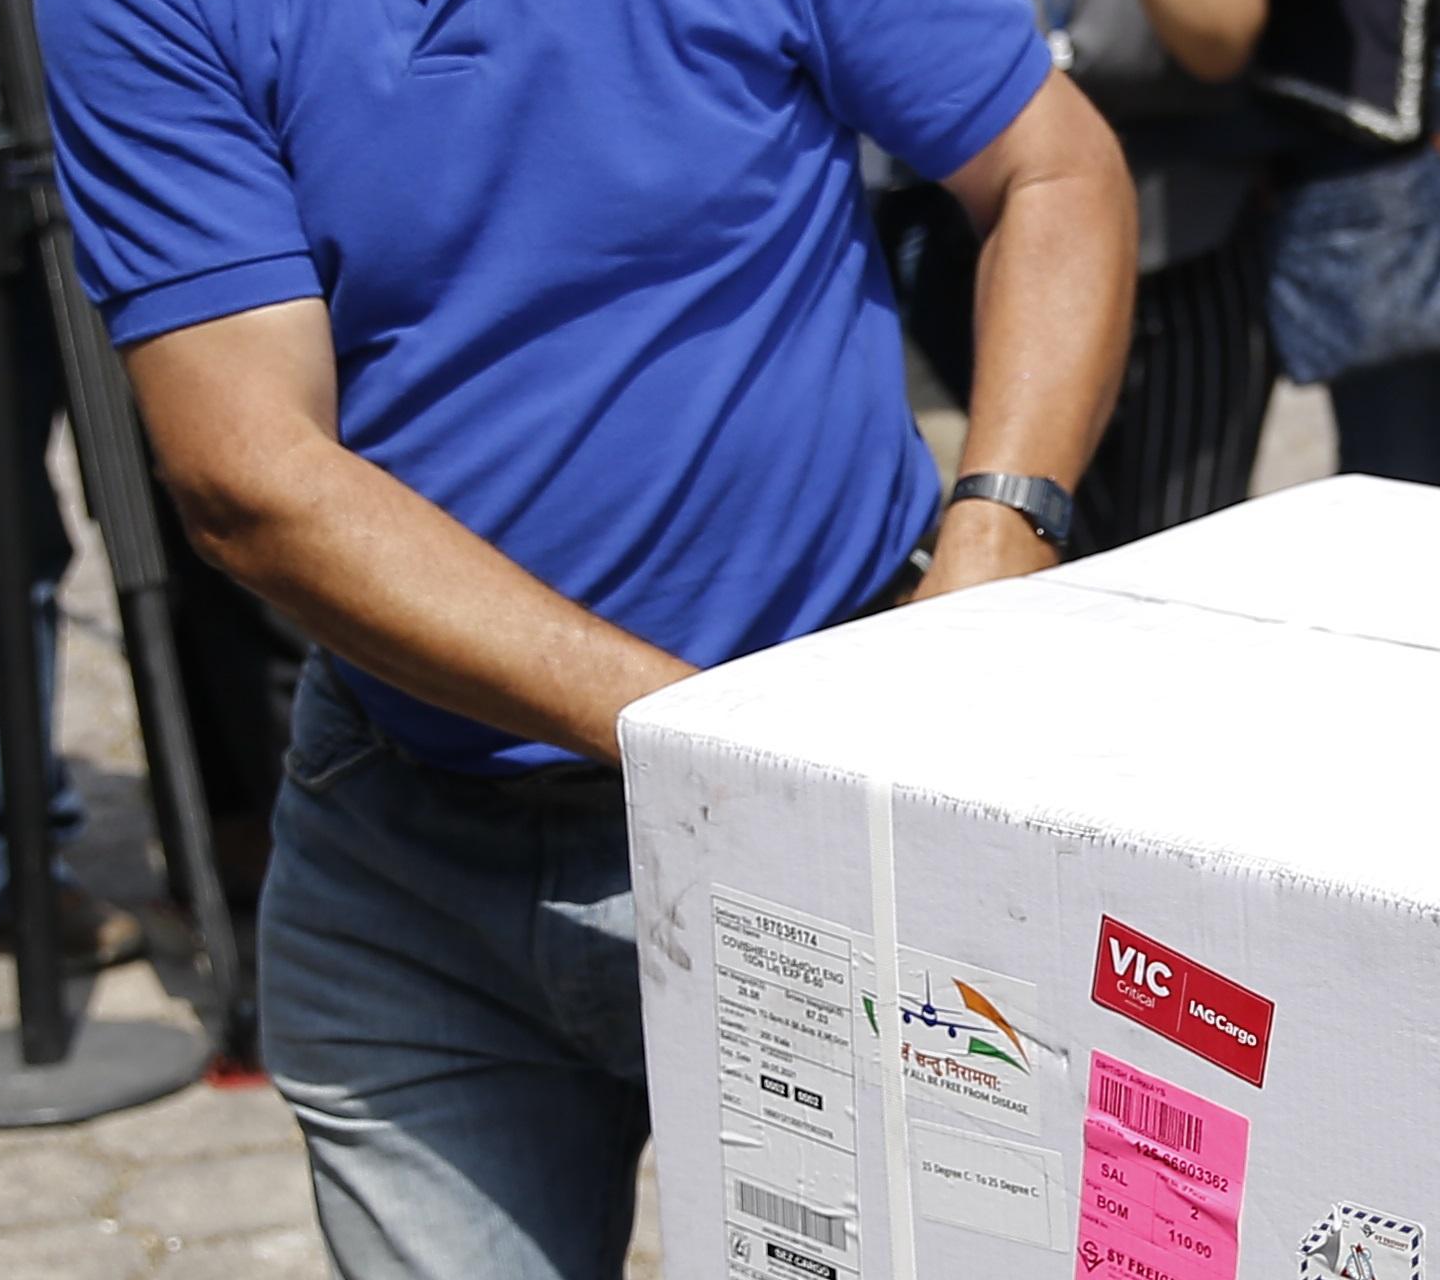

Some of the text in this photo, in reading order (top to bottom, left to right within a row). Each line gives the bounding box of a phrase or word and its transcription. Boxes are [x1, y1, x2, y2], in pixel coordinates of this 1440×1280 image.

[1109, 936, 1173, 997] VIC
[1116, 980, 1156, 1009] Critical
[910, 1070, 926, 1083] ALL
[927, 1075, 938, 1086] BE
[940, 1078, 962, 1094] FREE
[963, 1086, 989, 1102] FROM
[991, 1095, 1028, 1115] DISEASE
[934, 1164, 962, 1179] Degree
[975, 1174, 986, 1185] To
[988, 1177, 998, 1188] 25
[1000, 1180, 1029, 1196] Degree
[1100, 1163, 1128, 1187] SAL
[1096, 1194, 1129, 1220] BOM
[1190, 1206, 1200, 1220] 2
[1107, 1248, 1124, 1266] SV
[1169, 1229, 1212, 1259] 110.00
